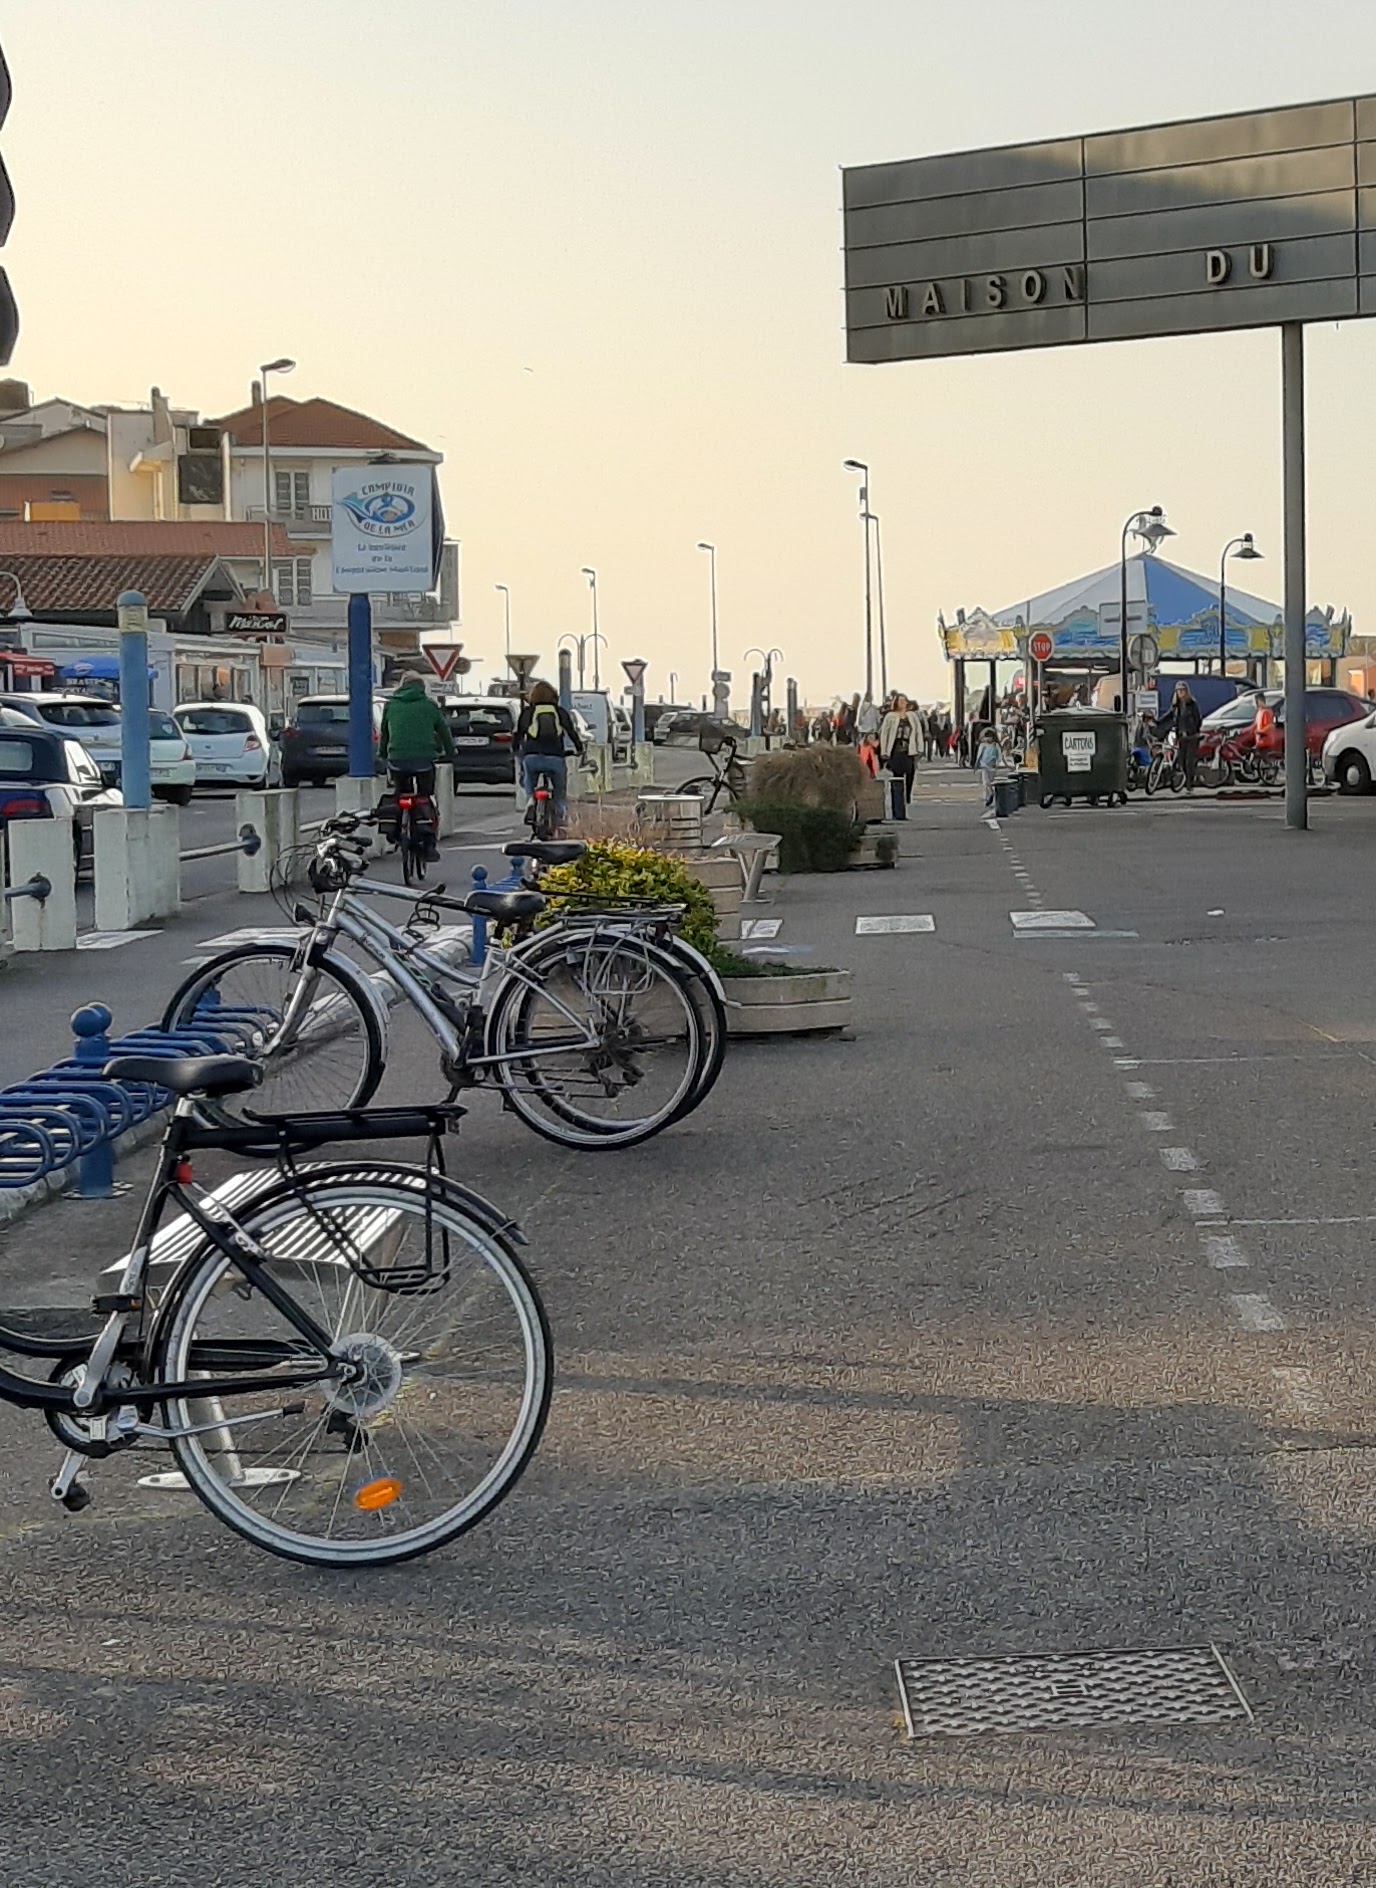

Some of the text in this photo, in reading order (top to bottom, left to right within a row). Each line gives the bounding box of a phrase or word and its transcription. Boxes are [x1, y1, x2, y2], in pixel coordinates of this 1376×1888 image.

[885, 265, 1082, 319] MAISON
[1206, 243, 1273, 285] DU
[1033, 641, 1050, 653] STOP
[1064, 735, 1094, 751] CARTONS
